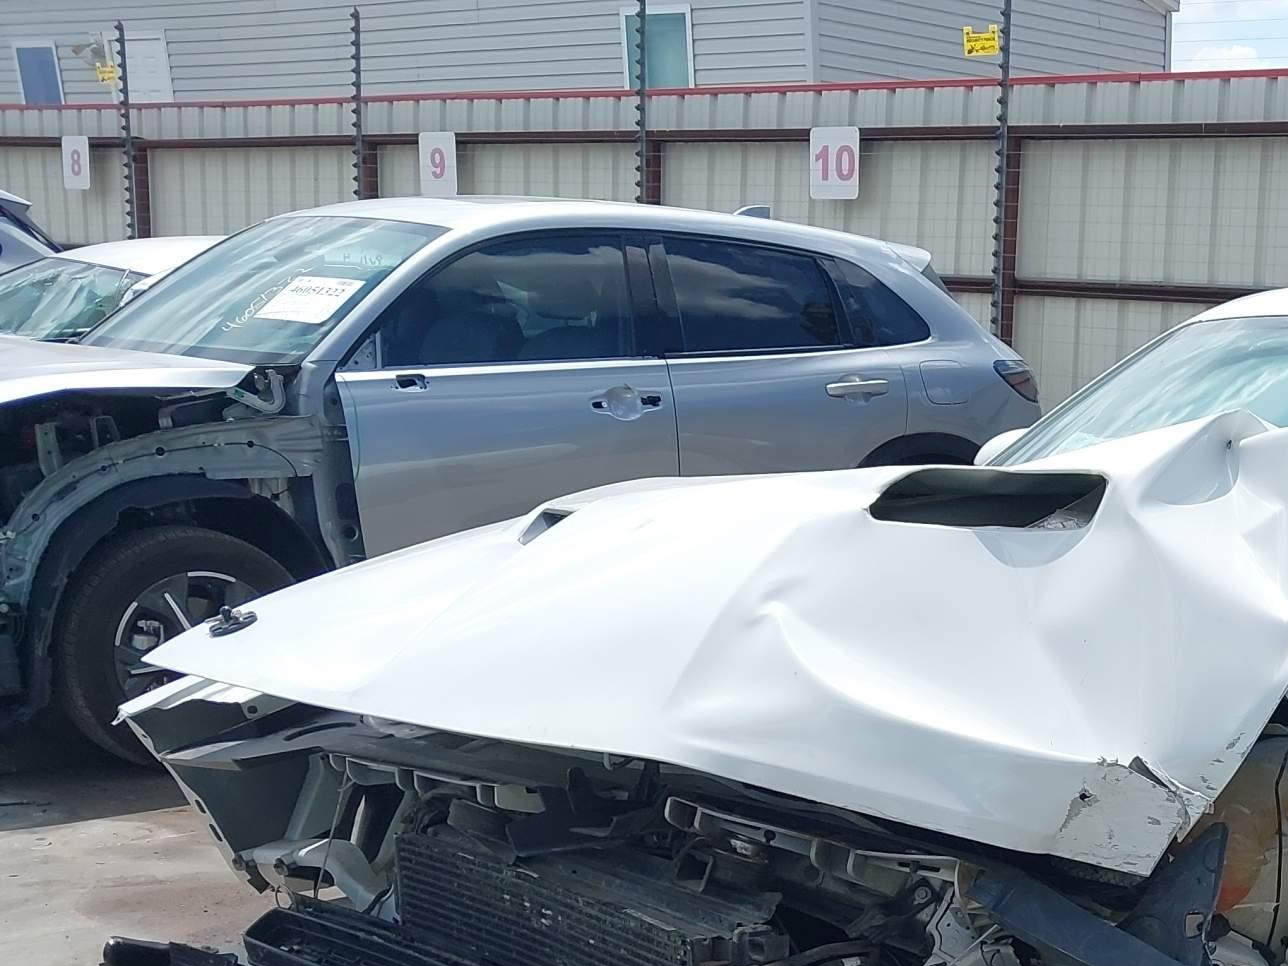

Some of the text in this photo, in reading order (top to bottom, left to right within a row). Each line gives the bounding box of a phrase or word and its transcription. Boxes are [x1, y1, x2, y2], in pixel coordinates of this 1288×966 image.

[71, 150, 81, 176] 8
[431, 147, 445, 179] 9
[815, 145, 855, 181] 10
